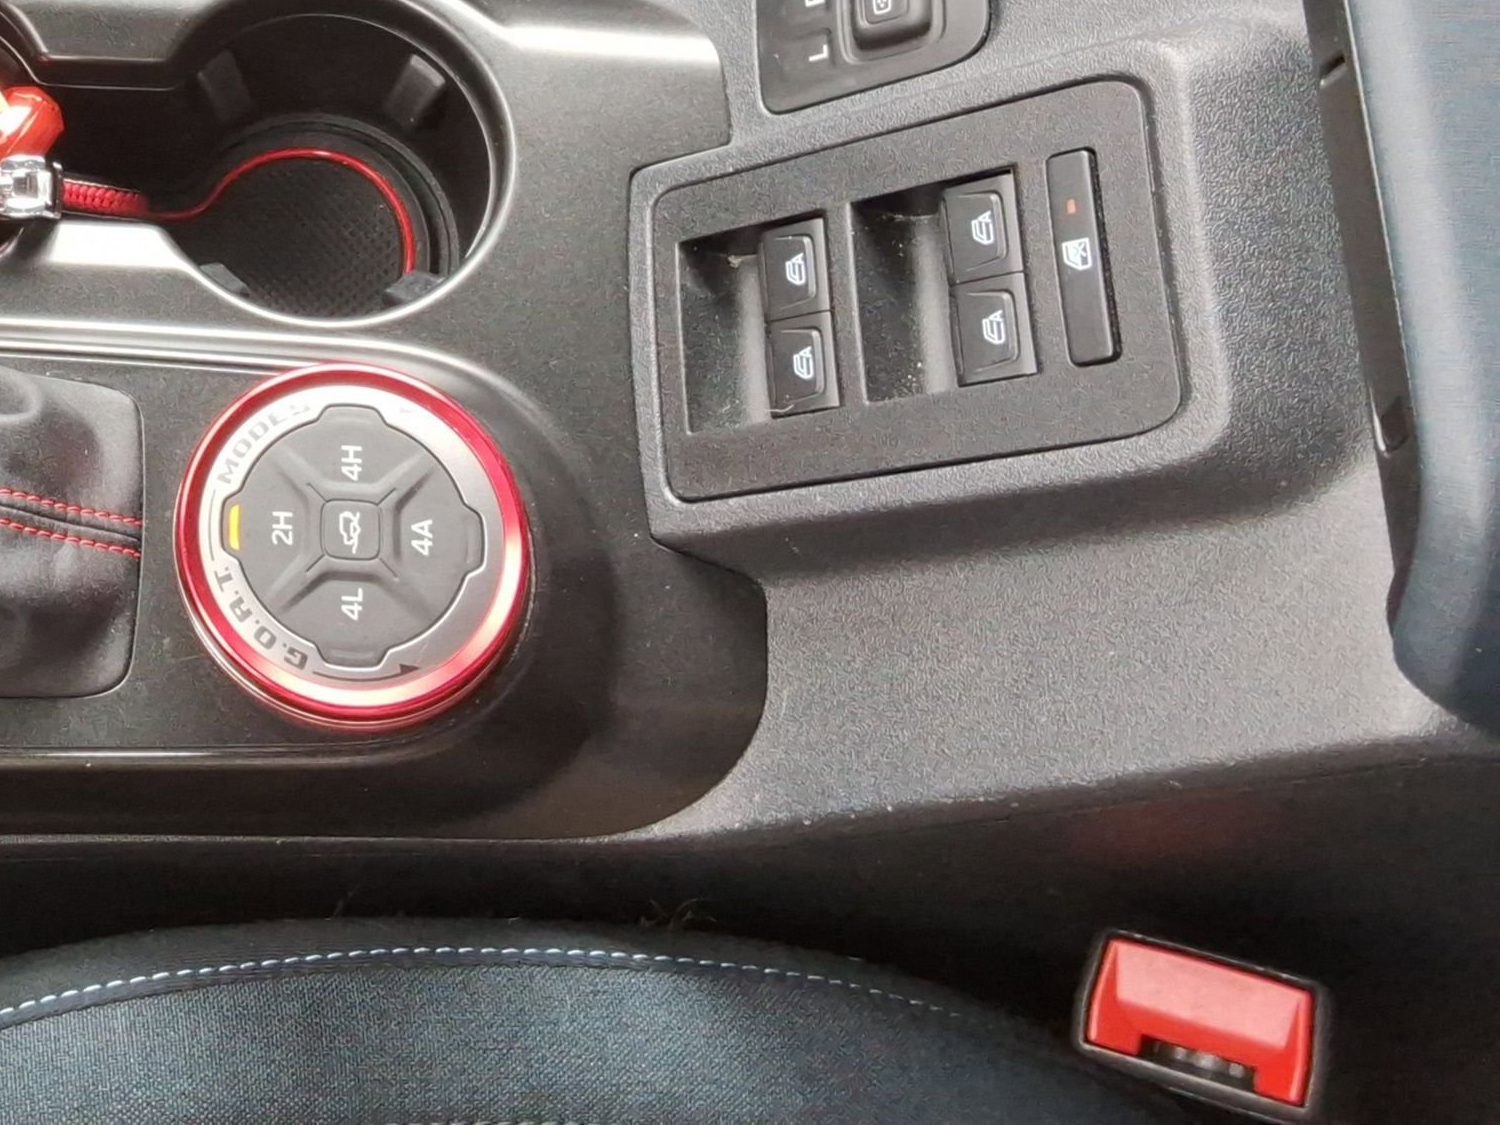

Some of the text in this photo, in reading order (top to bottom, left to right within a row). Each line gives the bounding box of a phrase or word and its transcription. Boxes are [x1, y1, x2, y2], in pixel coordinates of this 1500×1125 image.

[808, 44, 828, 62] L
[341, 445, 363, 481] 4H
[272, 511, 293, 545] 2H
[411, 519, 433, 556] 4A
[341, 588, 363, 620] 4L
